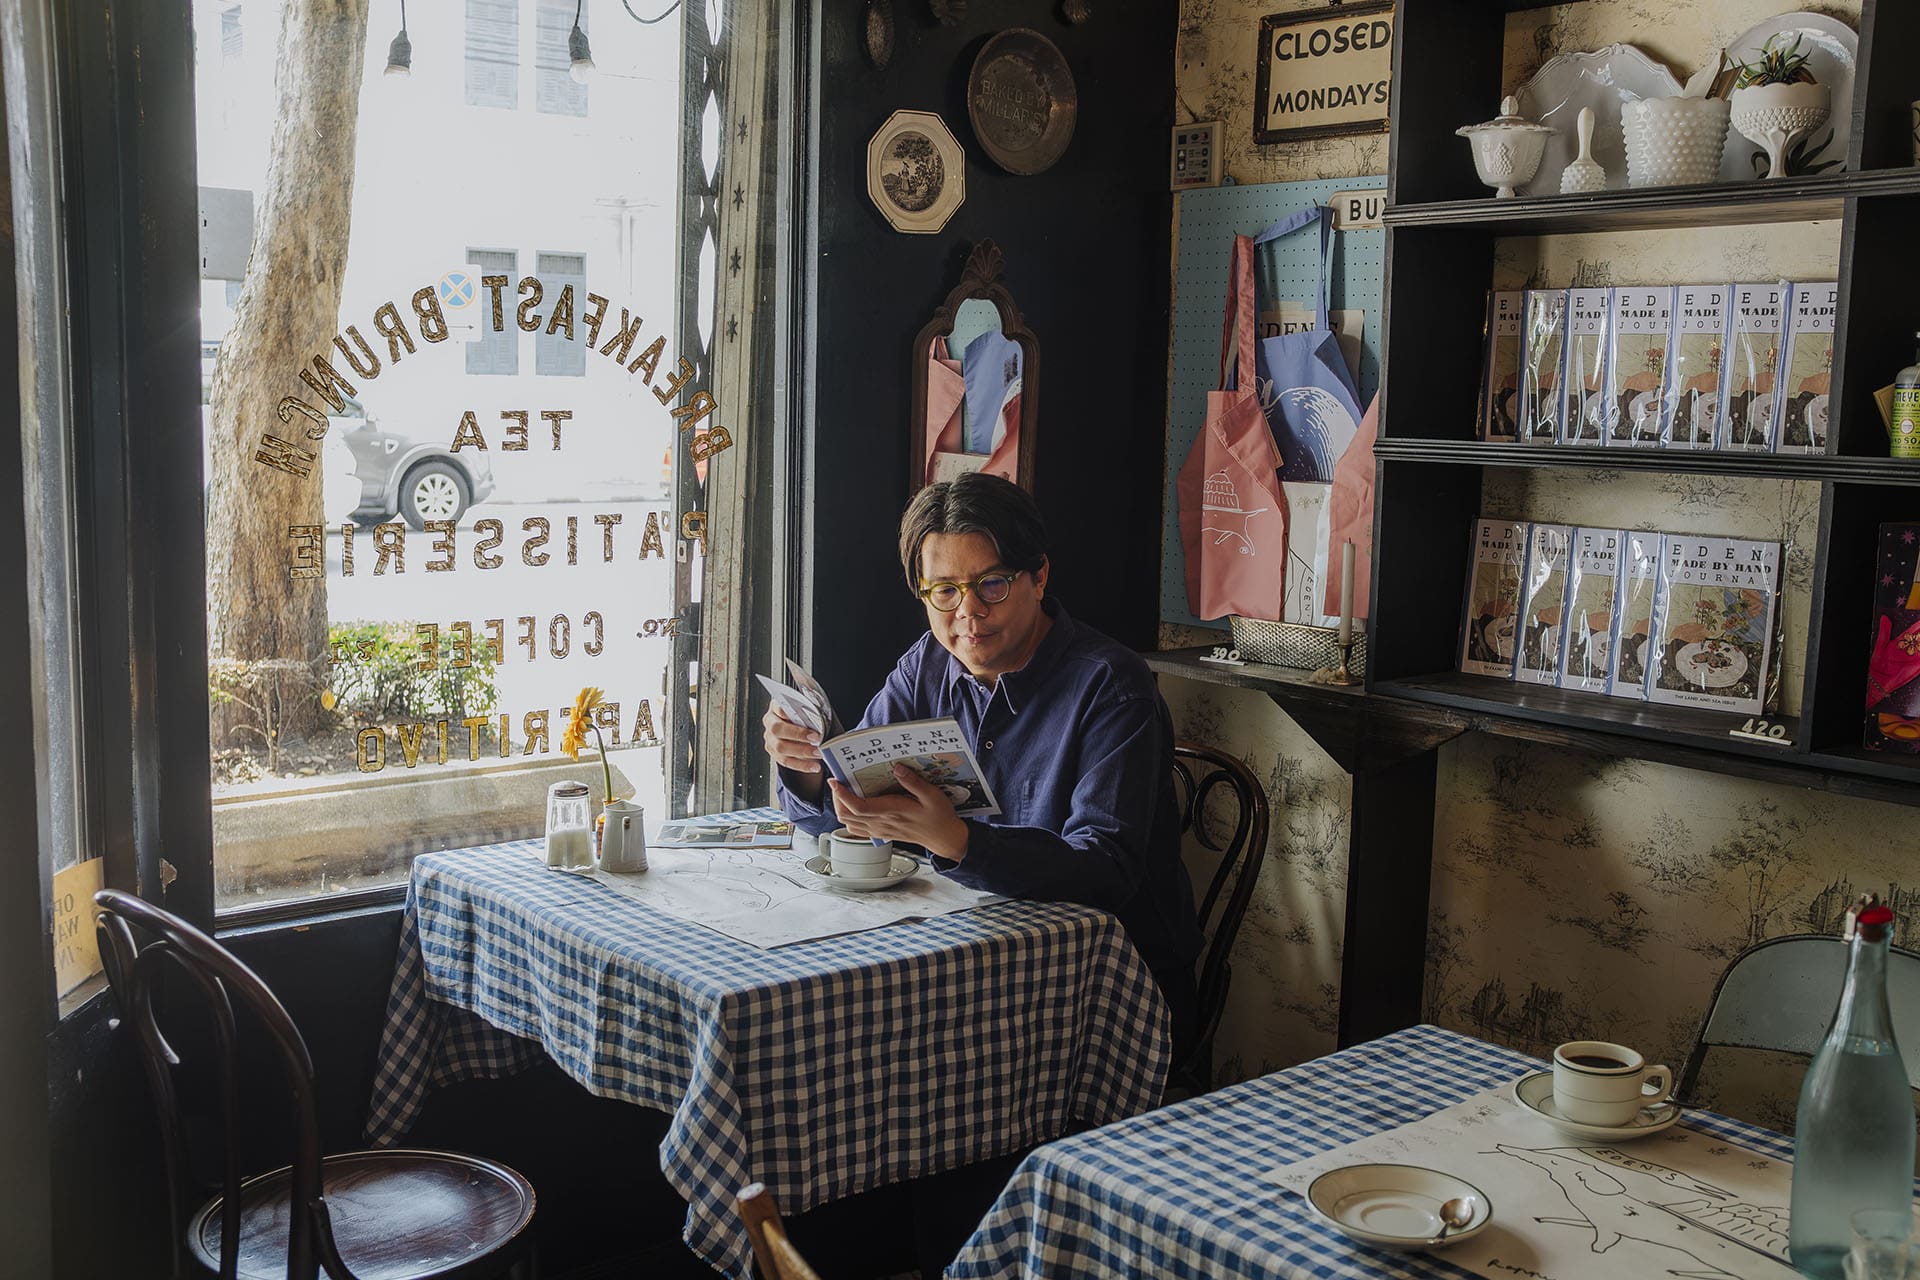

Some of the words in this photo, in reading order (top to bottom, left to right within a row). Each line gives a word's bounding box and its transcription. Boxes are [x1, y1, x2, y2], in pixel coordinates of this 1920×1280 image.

[1275, 21, 1391, 61] CLOSED
[1272, 80, 1388, 115] MONDAYS
[1575, 311, 1607, 319] MAD
[1620, 310, 1655, 318] MADE
[1683, 308, 1720, 317] MADE
[1740, 307, 1778, 316] MADE
[1481, 540, 1512, 550] MADE
[1671, 559, 1707, 568] MADE
[1712, 561, 1730, 571] BY
[1735, 564, 1772, 574] HAND
[1670, 570, 1771, 586] JOURNAL
[1210, 646, 1241, 660] 390
[1741, 718, 1786, 739] 420
[845, 746, 886, 762] MADE
[892, 741, 912, 750] BY
[917, 737, 959, 747] HAND
[849, 744, 963, 770] JOURNAL
[1595, 1149, 1678, 1181] EDEN'S
